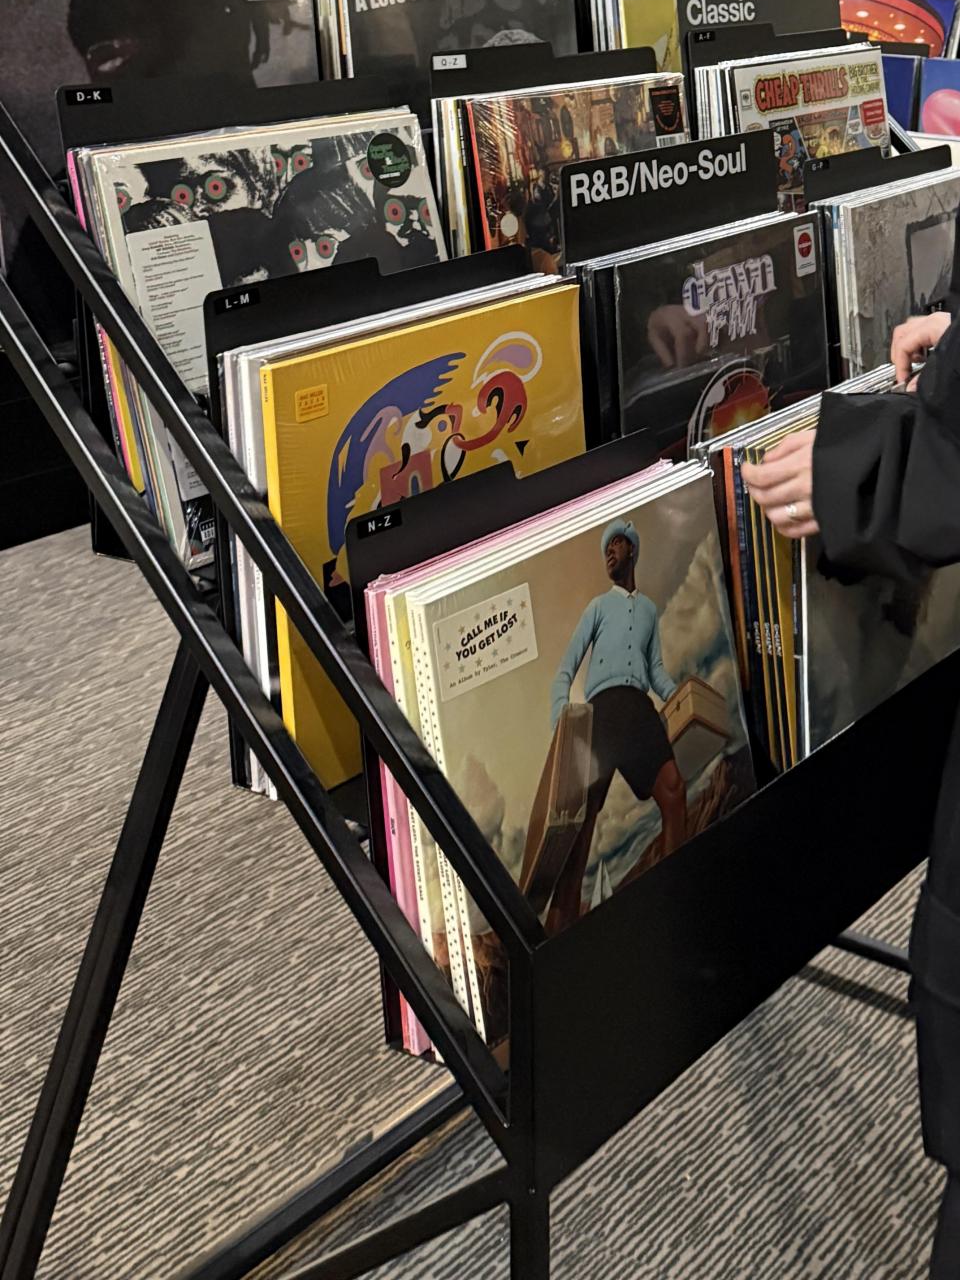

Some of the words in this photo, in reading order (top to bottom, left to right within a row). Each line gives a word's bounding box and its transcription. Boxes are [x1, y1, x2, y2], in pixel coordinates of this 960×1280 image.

[755, 73, 800, 113] CHEAP
[799, 66, 849, 104] THRILLS
[570, 143, 748, 209] R&B/Neo-Soul
[455, 644, 477, 662] YOU
[478, 632, 496, 651] GET
[496, 612, 518, 639] LOST
[460, 625, 483, 648] CALL
[484, 614, 499, 631] ME
[499, 610, 509, 623] IF
